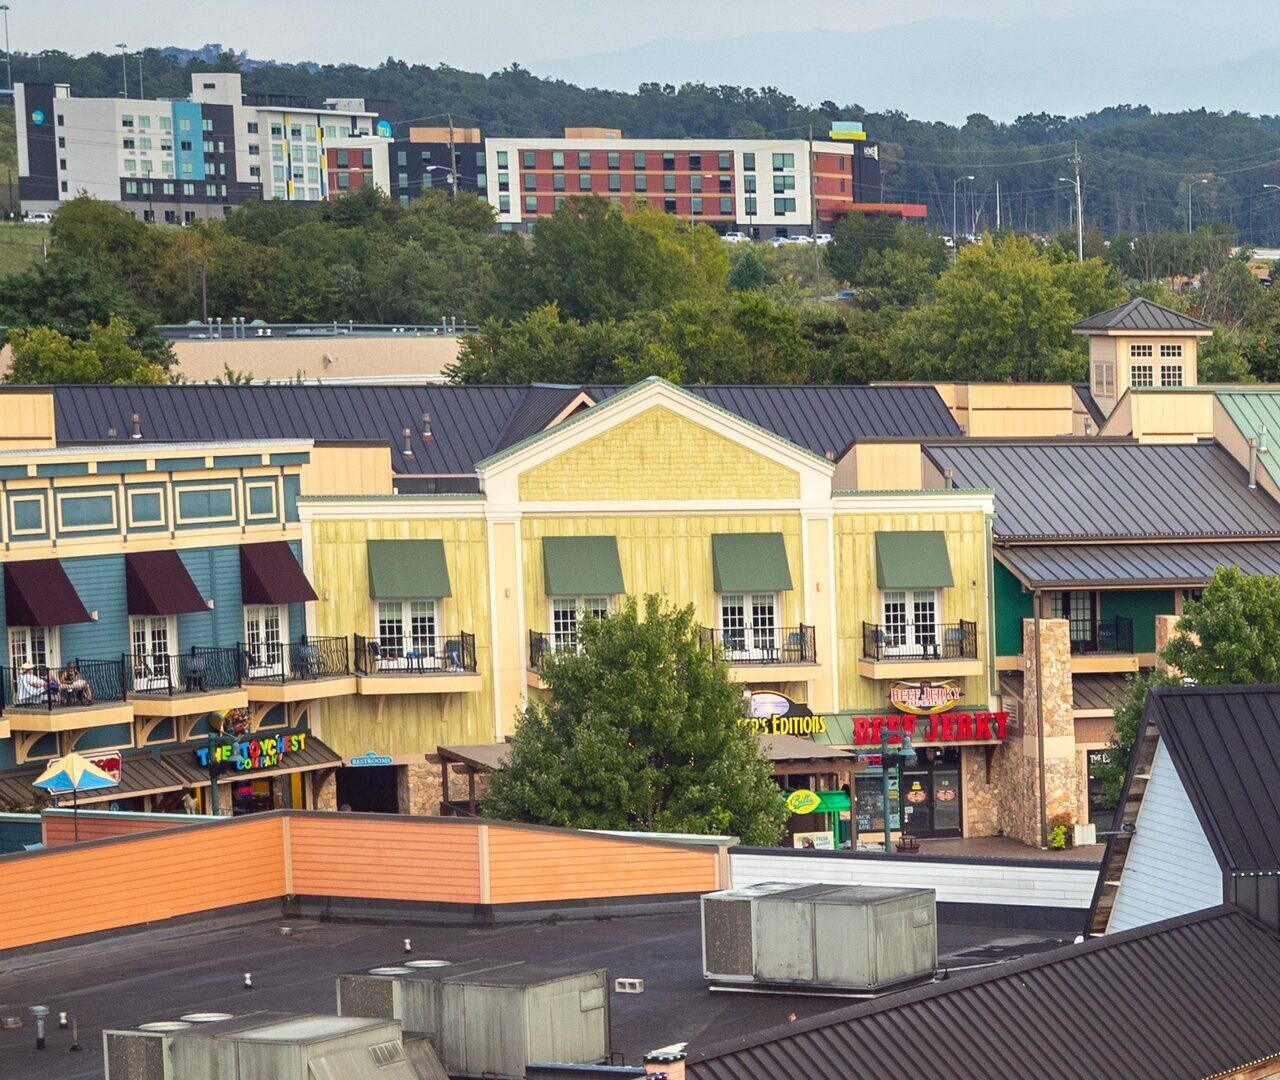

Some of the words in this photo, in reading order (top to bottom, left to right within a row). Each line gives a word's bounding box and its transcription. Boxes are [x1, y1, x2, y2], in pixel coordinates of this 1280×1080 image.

[890, 688, 921, 702] BEEF
[921, 687, 961, 701] JERKY
[853, 714, 917, 745] BEEF
[925, 711, 1011, 742] JERKY
[352, 757, 391, 765] RESTROOMS
